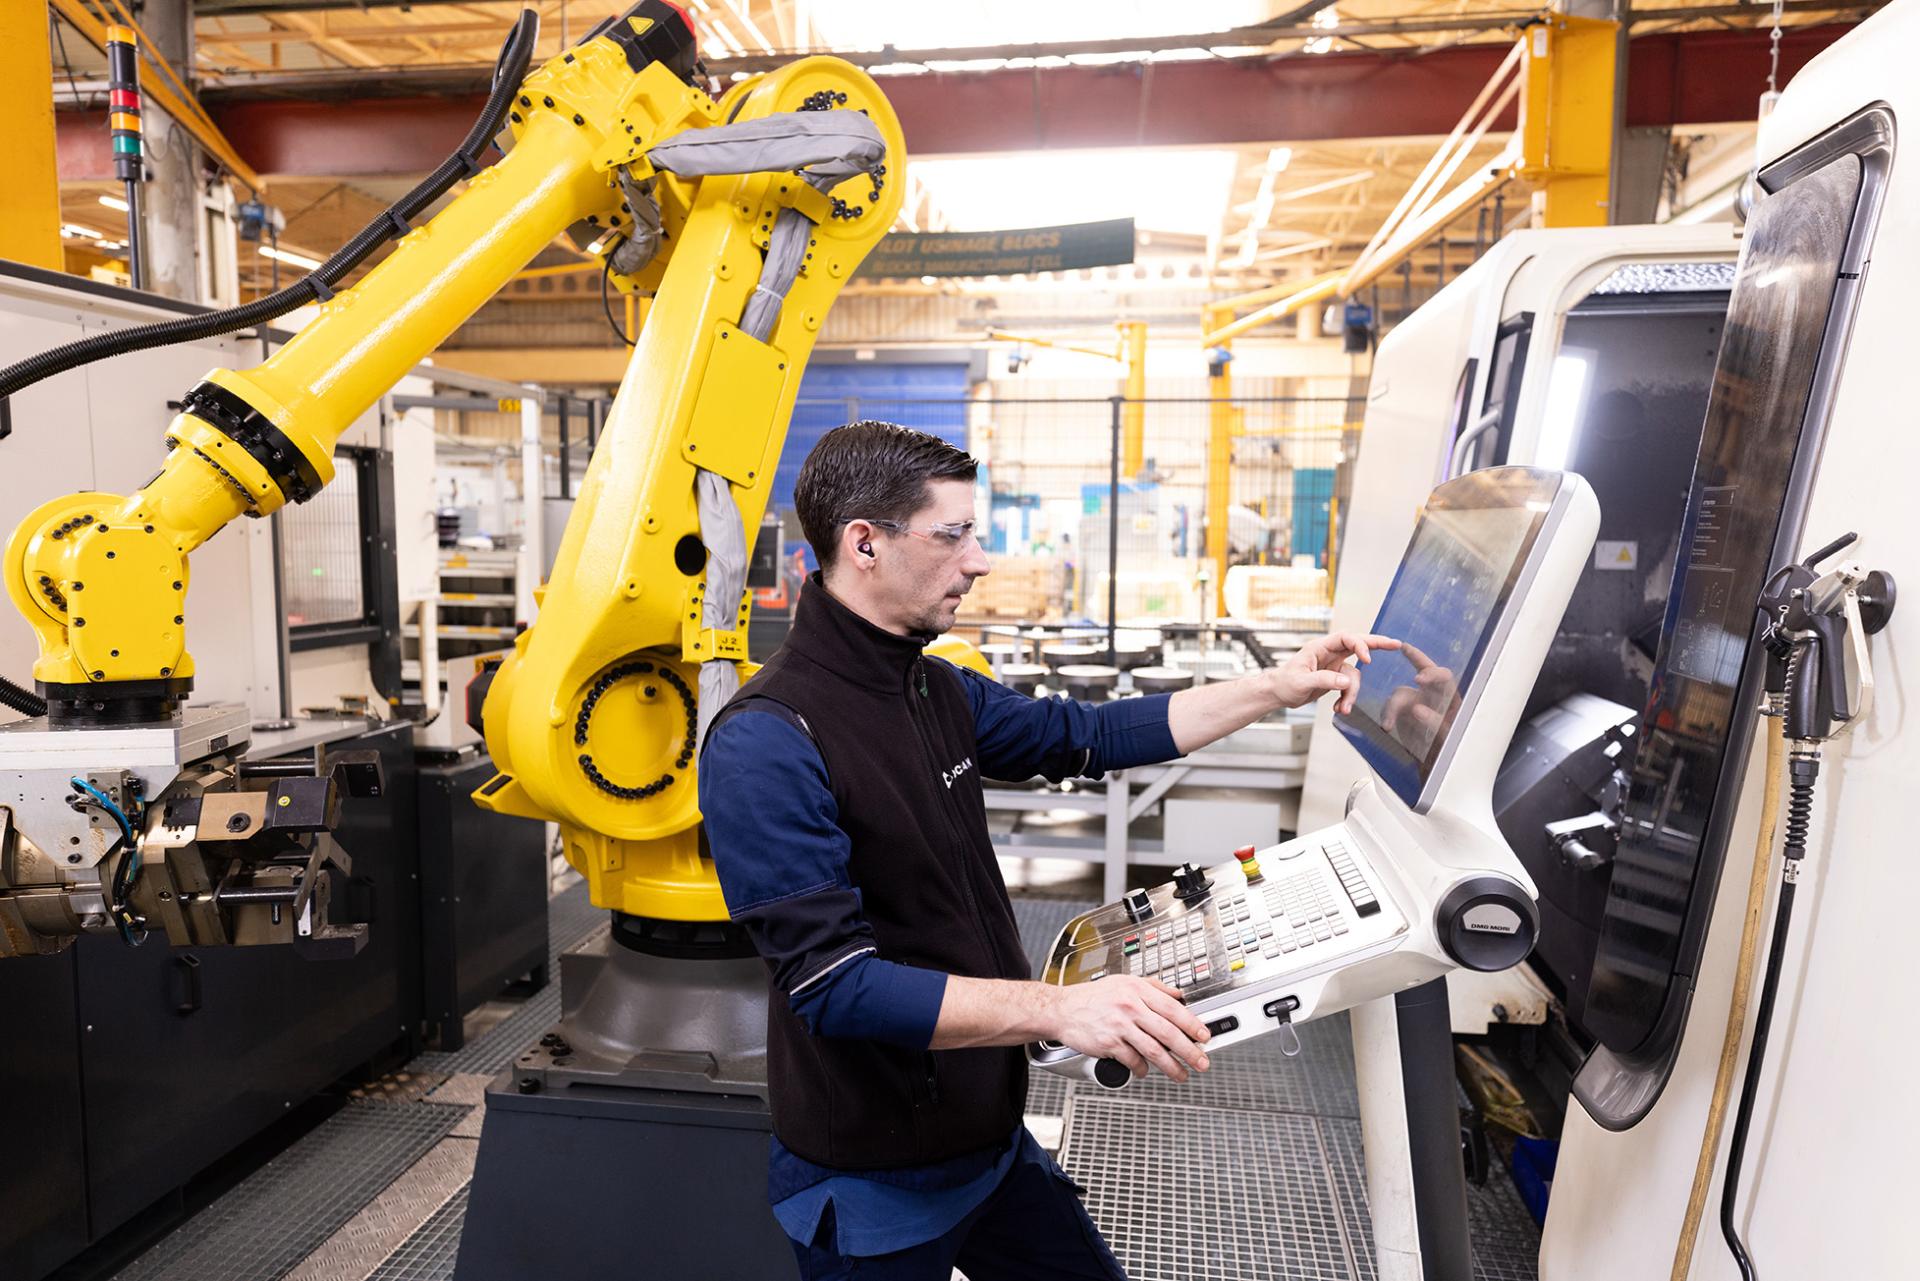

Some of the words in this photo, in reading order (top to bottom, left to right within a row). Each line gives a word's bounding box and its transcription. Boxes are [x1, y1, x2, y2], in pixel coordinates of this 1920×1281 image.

[1002, 230, 1062, 251] BLOCS
[1032, 252, 1062, 270] CELL
[1490, 924, 1511, 932] MORI
